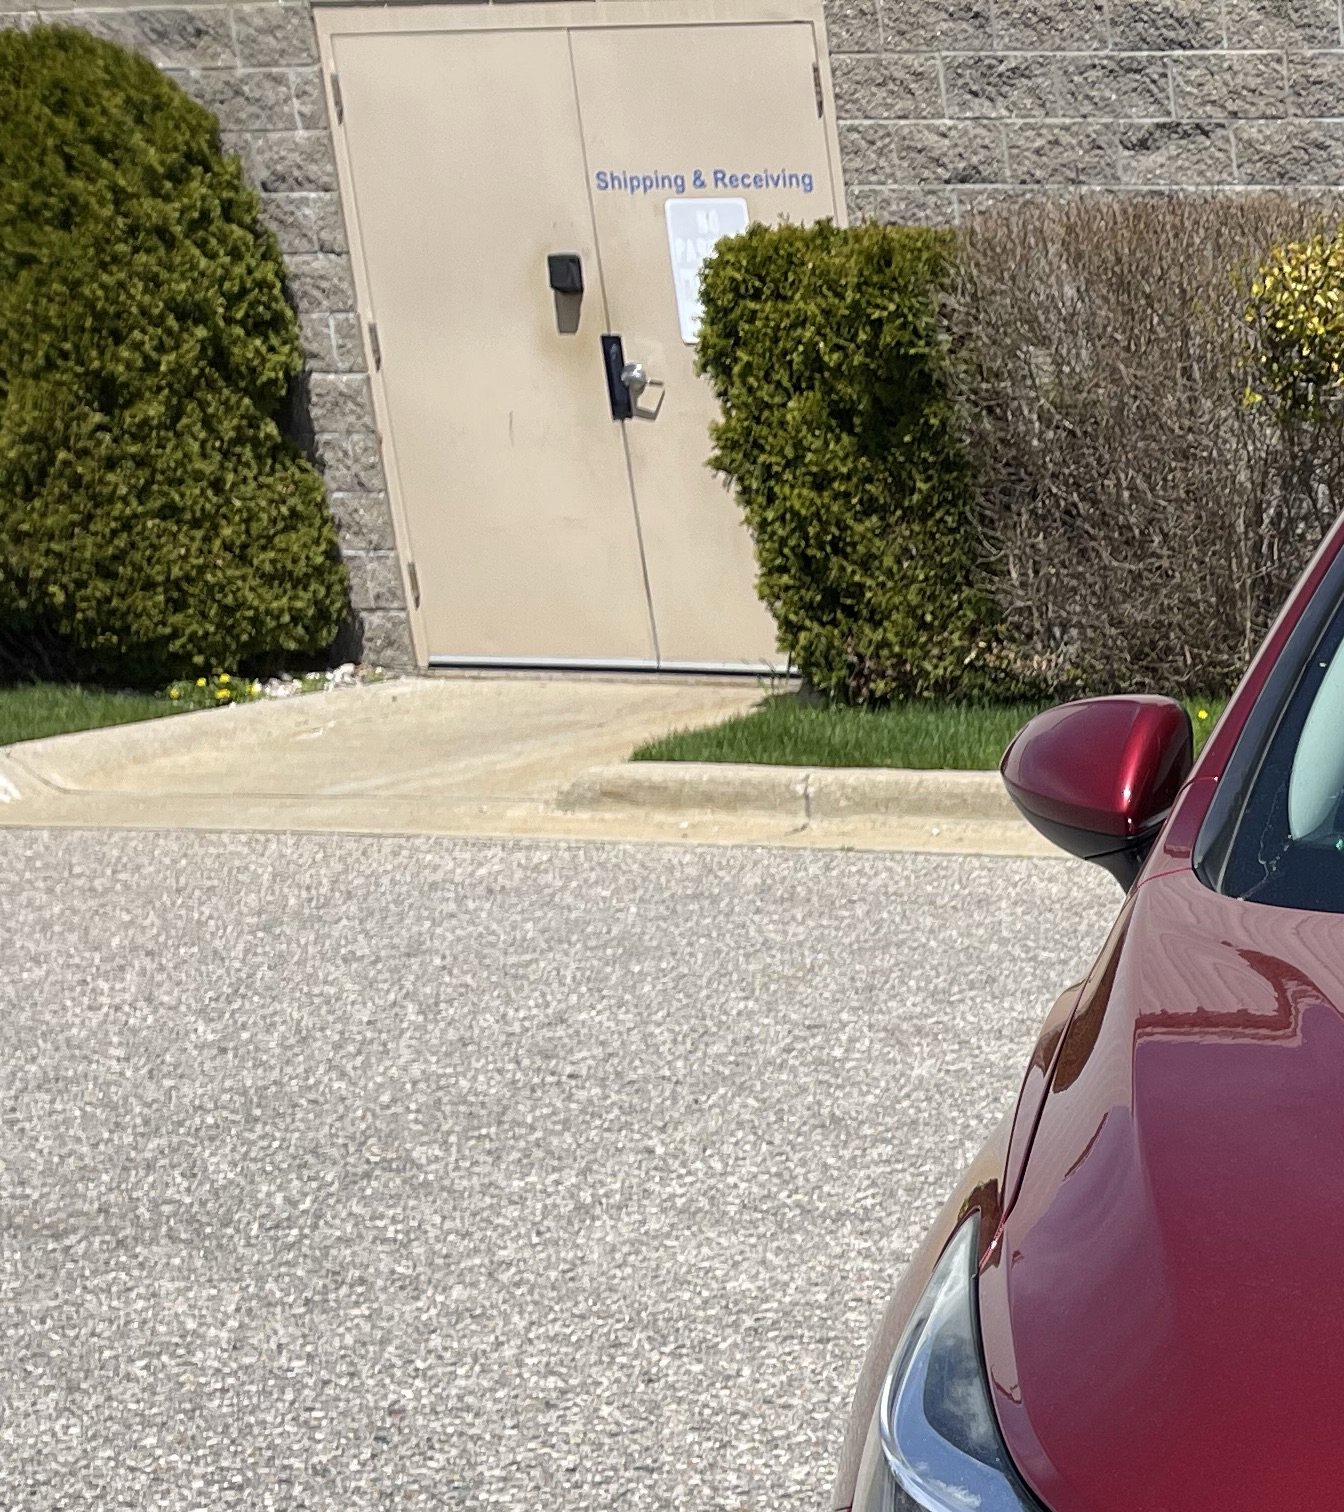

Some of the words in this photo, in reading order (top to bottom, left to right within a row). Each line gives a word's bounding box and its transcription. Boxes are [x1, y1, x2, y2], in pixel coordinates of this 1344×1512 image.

[595, 170, 686, 194] Shipping
[692, 169, 707, 189] &
[712, 168, 814, 193] Receiving
